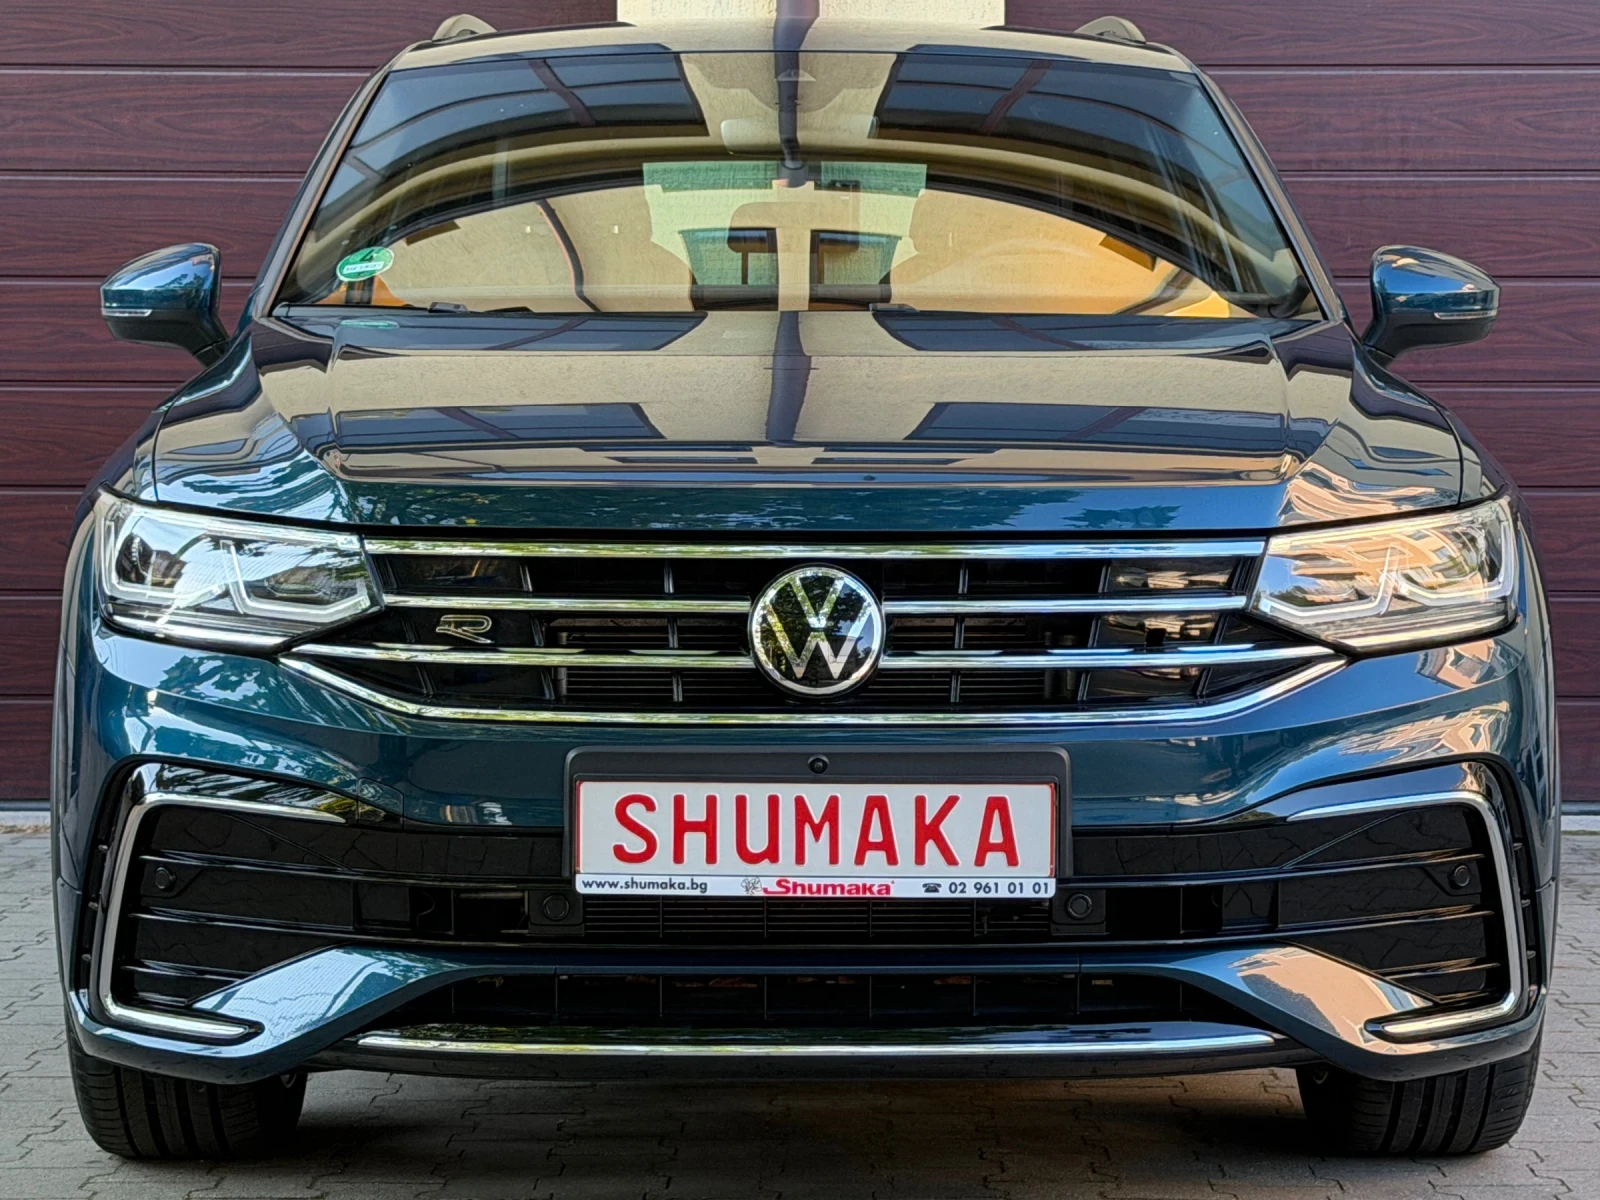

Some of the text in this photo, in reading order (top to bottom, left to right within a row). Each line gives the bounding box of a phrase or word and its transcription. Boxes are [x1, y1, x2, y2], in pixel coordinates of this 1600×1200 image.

[435, 614, 493, 644] R
[612, 793, 1020, 867] SHUMAKA
[581, 876, 708, 894] www.shumaka.bg
[762, 878, 892, 896] Shumaka
[948, 881, 1049, 895] 02 961 01 01
